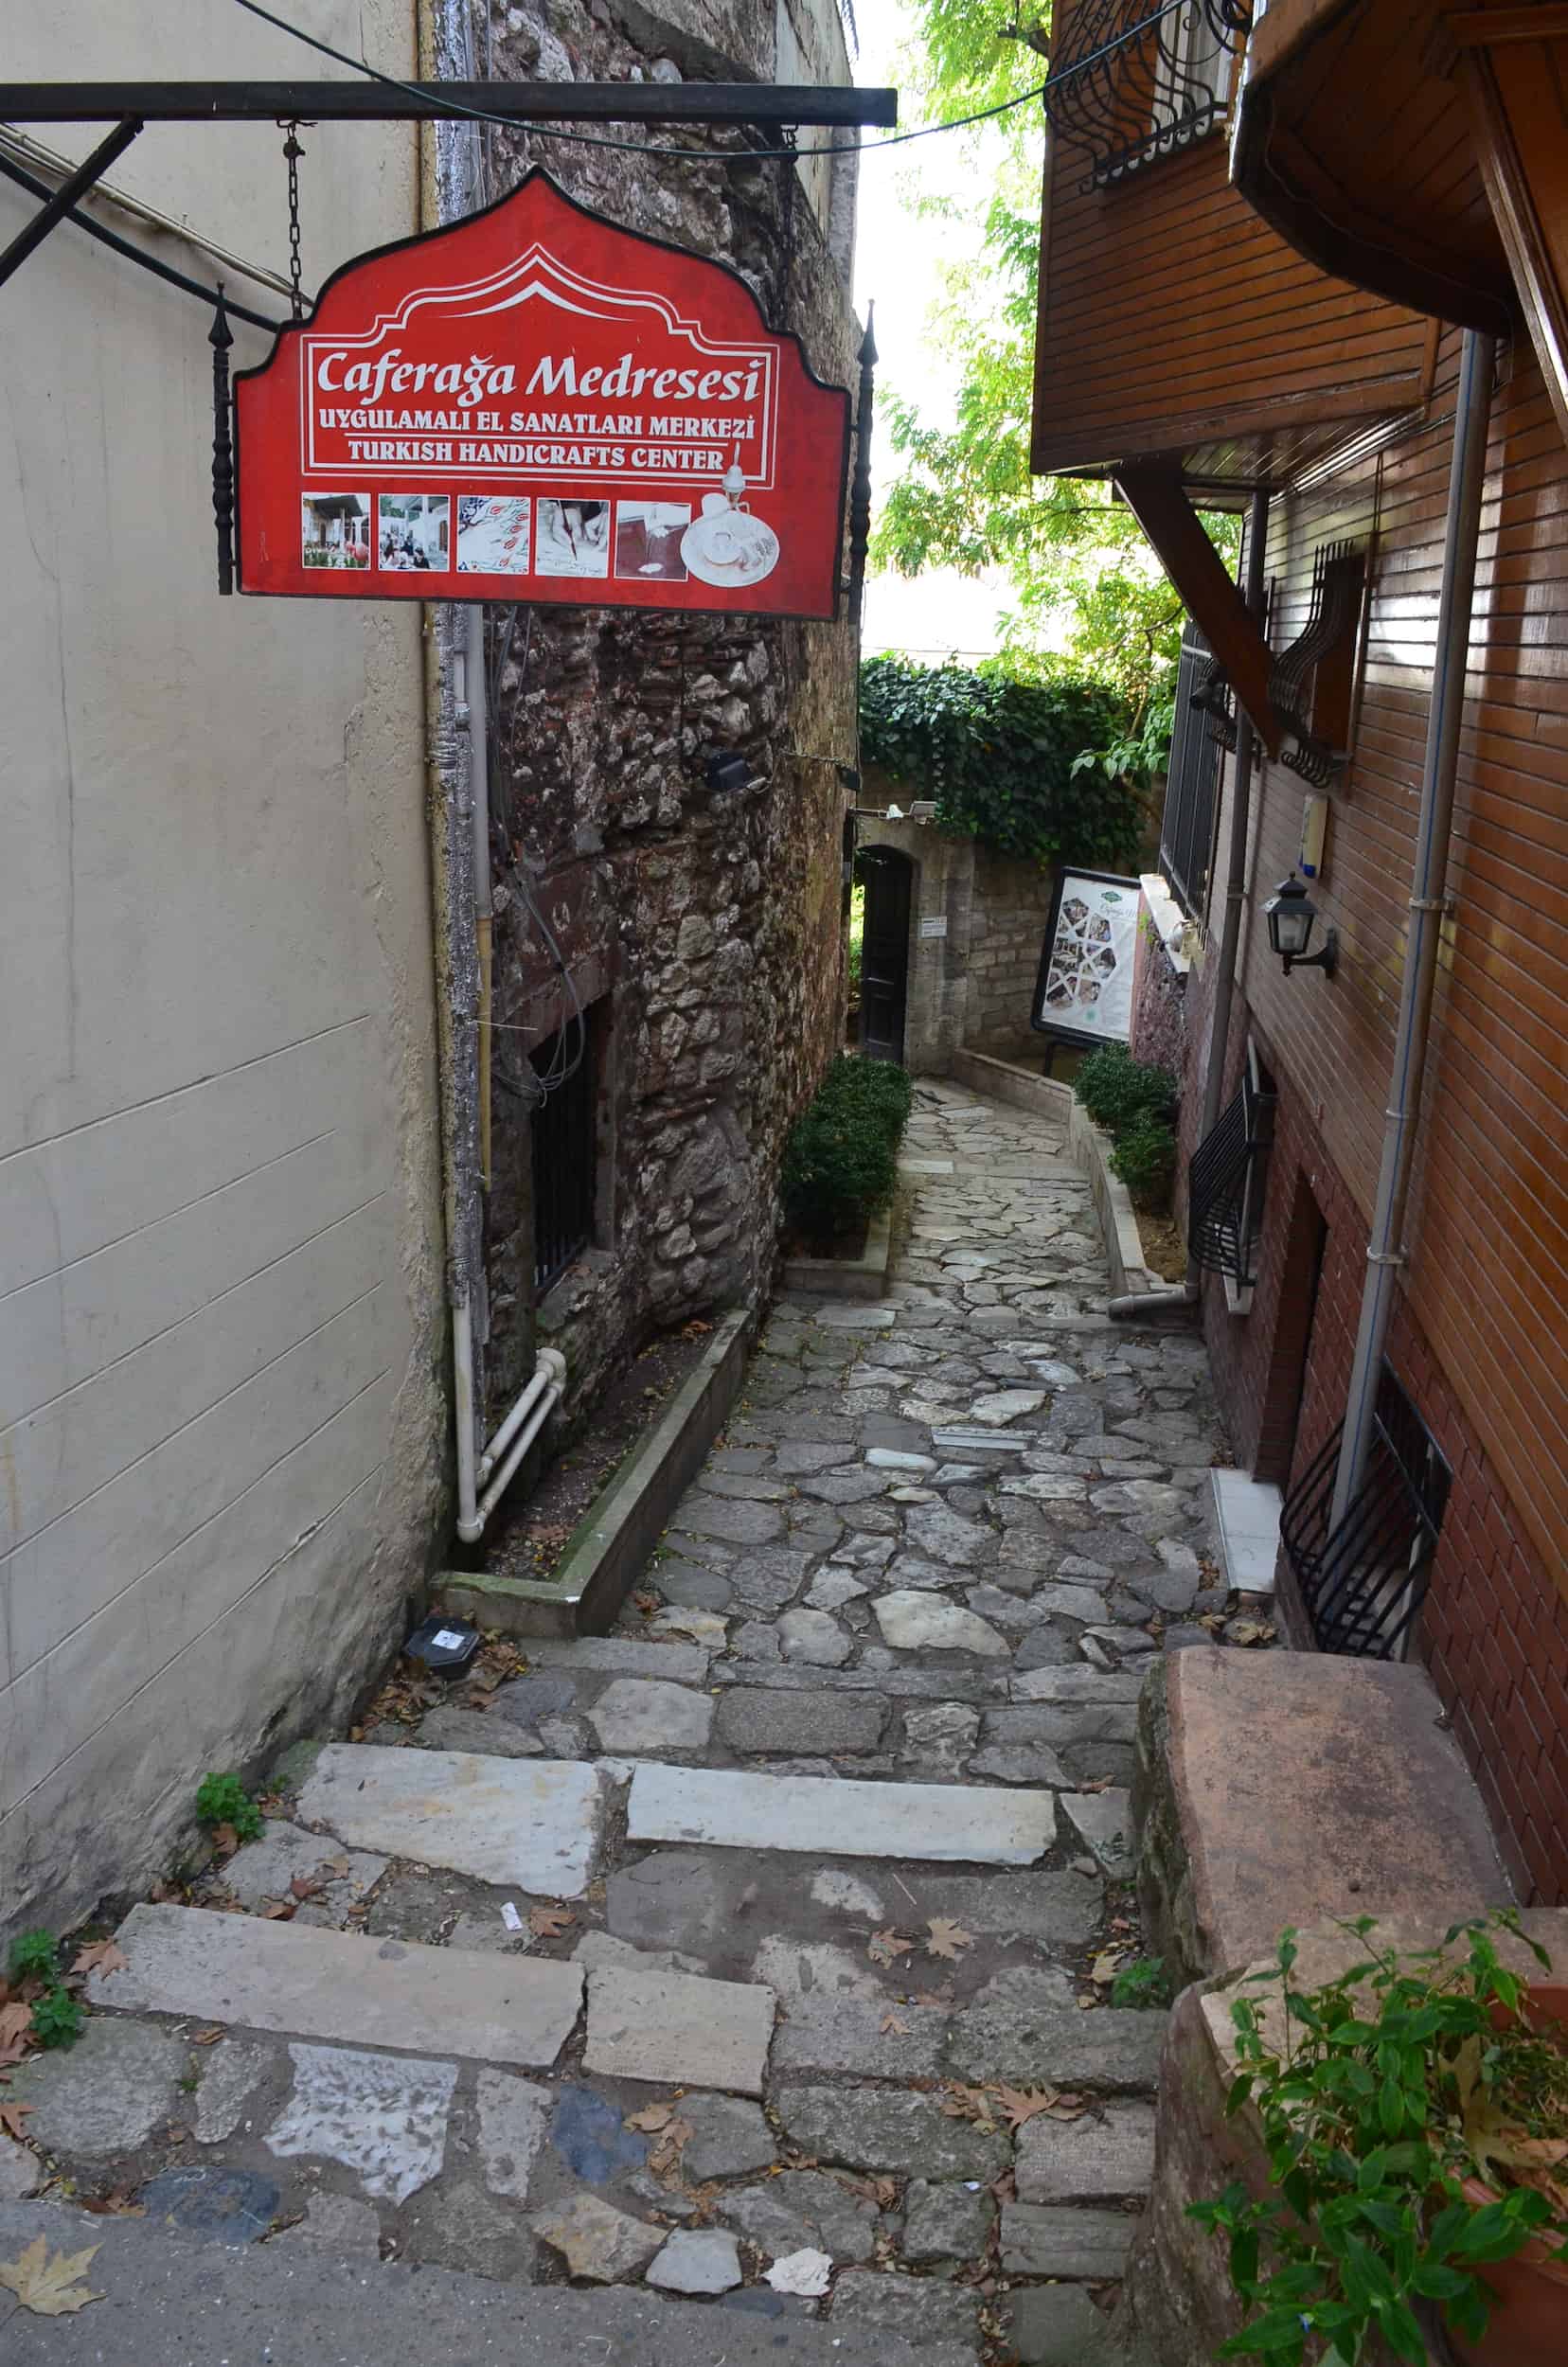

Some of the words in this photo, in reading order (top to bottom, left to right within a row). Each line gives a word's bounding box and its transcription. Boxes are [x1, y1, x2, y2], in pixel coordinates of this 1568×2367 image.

[317, 348, 517, 408] Caferağa
[525, 352, 765, 401] Medresesi
[319, 408, 471, 431] UYGULAMALI
[476, 411, 504, 432] EL
[509, 412, 643, 436] SANATLARI
[649, 415, 756, 440] MERKEZİ
[347, 440, 454, 462] TURKISH
[458, 442, 626, 467] HANDICRAFTS
[631, 448, 724, 471] CENTER
